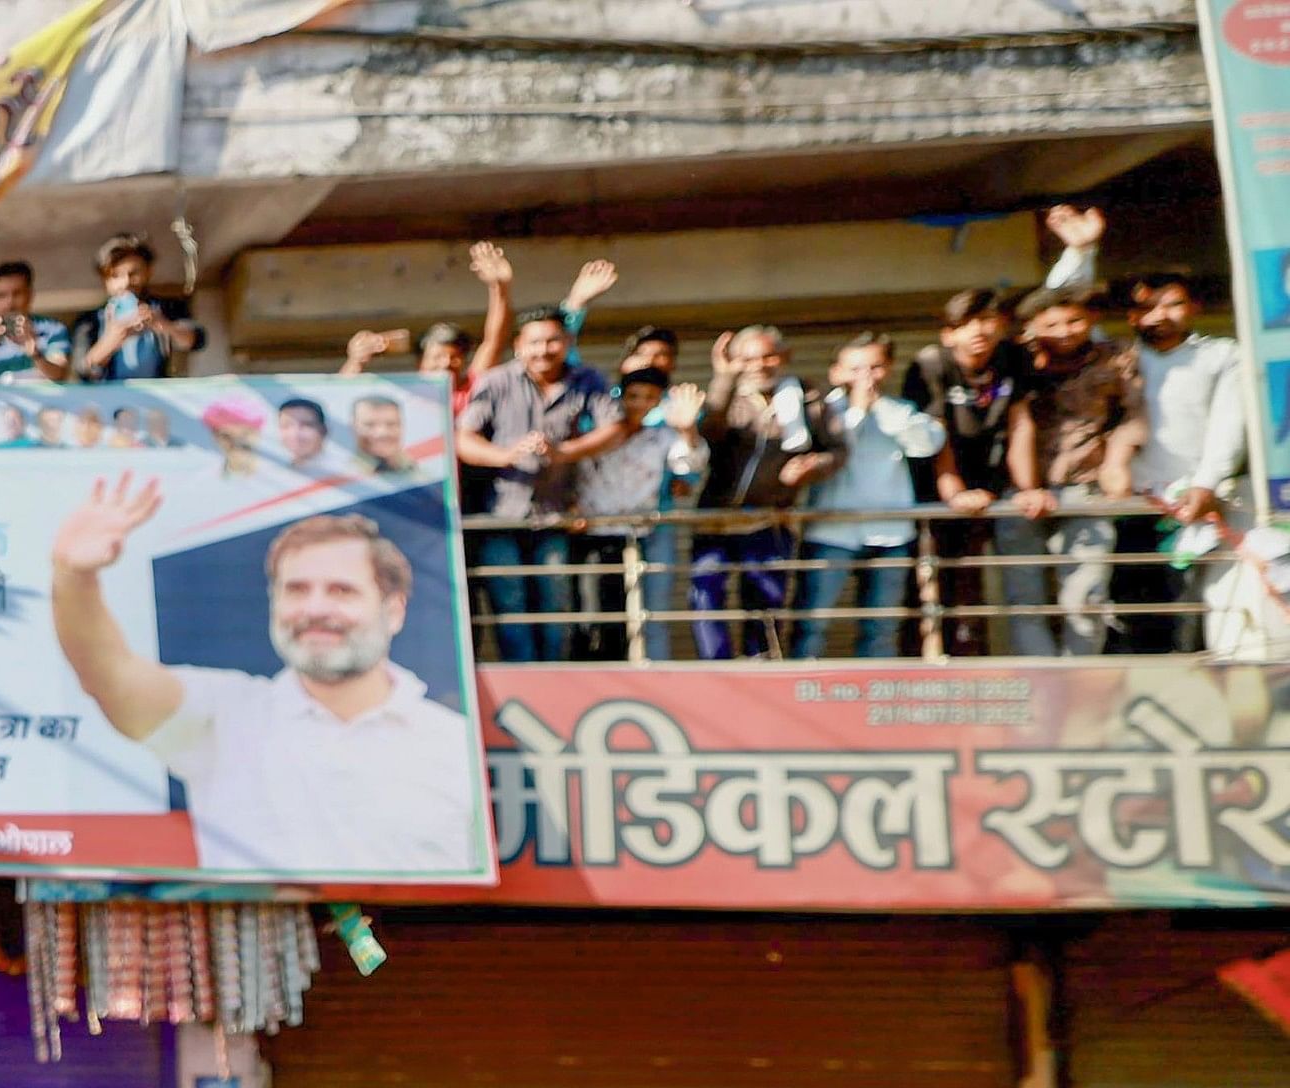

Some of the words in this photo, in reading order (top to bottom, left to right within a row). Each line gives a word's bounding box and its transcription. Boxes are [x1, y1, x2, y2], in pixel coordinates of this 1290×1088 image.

[36, 714, 80, 741] का
[487, 697, 957, 869] मेडिकल
[976, 696, 1290, 871] स्टोर
